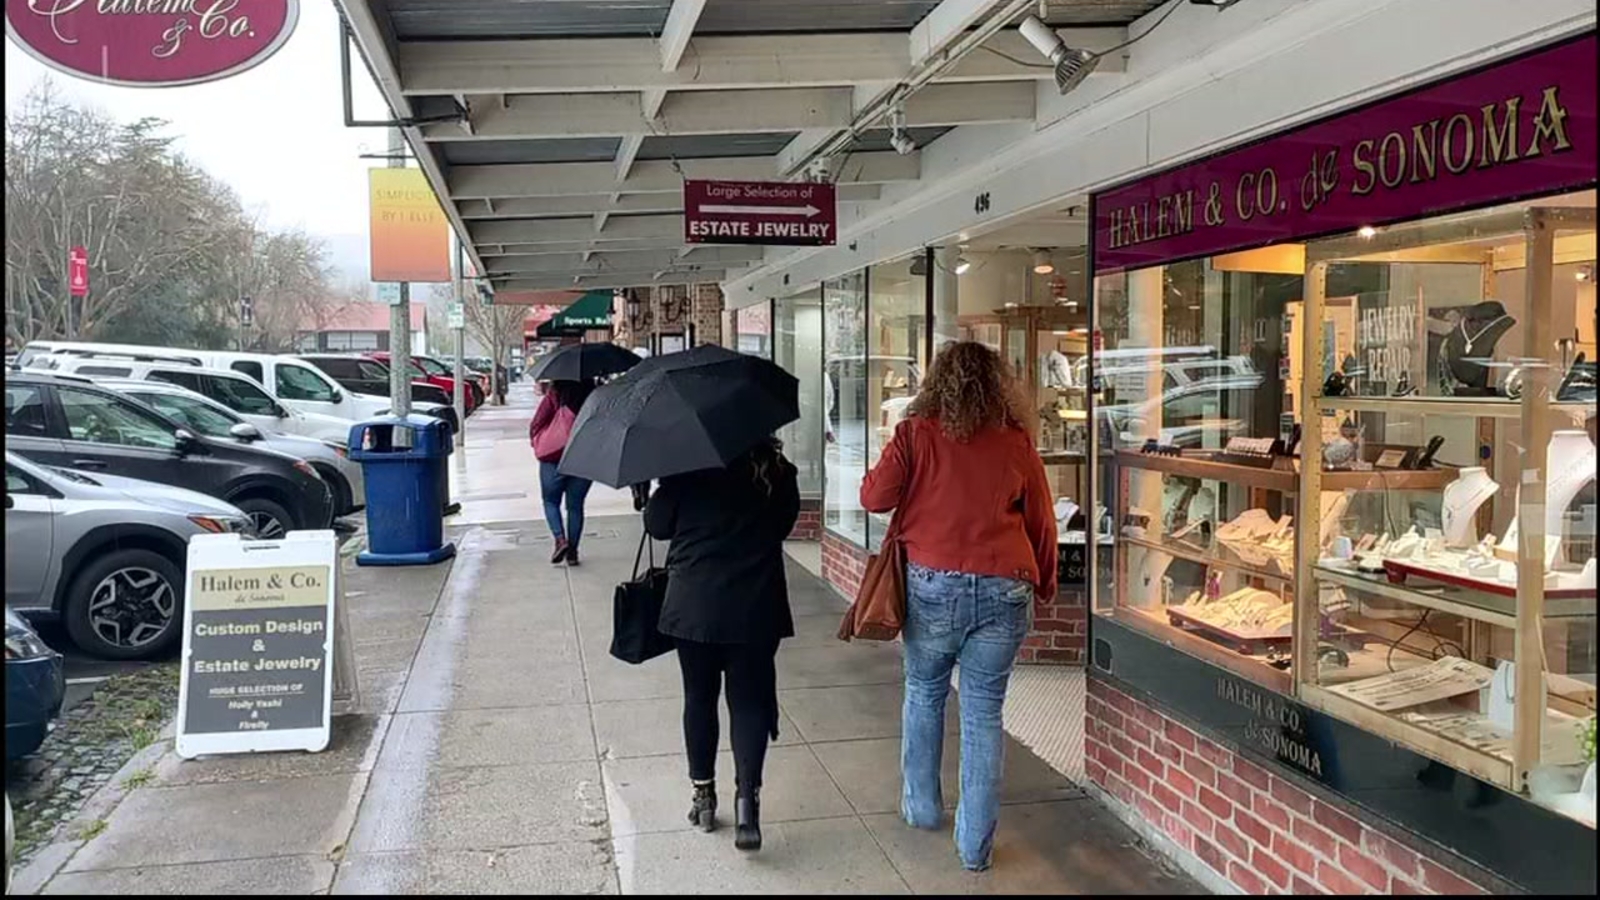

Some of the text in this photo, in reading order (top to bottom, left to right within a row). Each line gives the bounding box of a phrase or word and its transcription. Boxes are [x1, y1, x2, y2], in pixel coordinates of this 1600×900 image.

[151, 0, 255, 57] & Co.
[1109, 85, 1571, 248] HALEM & CO. de SONOMA
[376, 189, 435, 200] SIMPLICIT
[706, 184, 814, 199] Large Selection of
[974, 191, 990, 214] 496
[382, 210, 396, 221] BY
[689, 220, 830, 237] ESTATE JEWELRY
[564, 315, 592, 326] Sports
[1360, 304, 1416, 349] JEWELRY
[1368, 346, 1411, 386] REPAIR
[201, 572, 321, 592] Halem & Co.
[195, 619, 323, 637] Custom Design
[252, 638, 266, 652] &
[194, 656, 321, 673] Estate Jewelry
[209, 683, 304, 695] HUGE SELECTION OF
[228, 700, 254, 710] Holly
[1217, 678, 1303, 734] HALEM & CO.
[239, 720, 270, 730] Firefly
[1262, 727, 1322, 776] SONOMA
